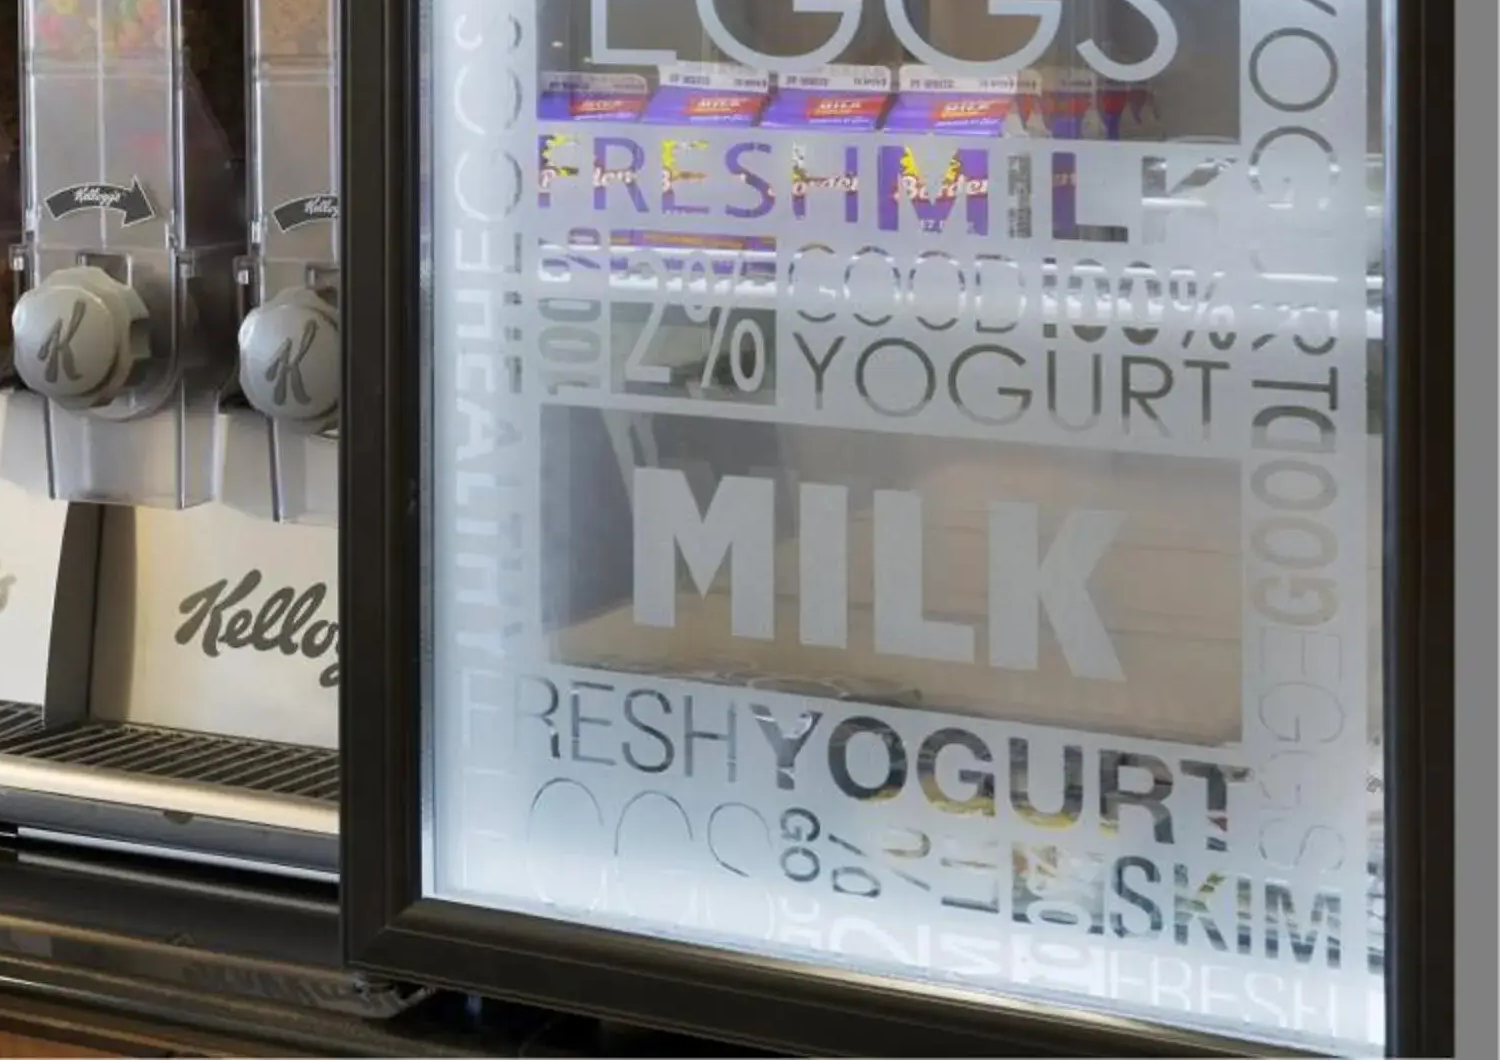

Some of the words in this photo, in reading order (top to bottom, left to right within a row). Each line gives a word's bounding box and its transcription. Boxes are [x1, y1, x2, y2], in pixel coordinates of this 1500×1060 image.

[537, 134, 859, 224] FRESH
[877, 143, 1238, 243] MILK
[37, 300, 87, 382] K
[265, 319, 319, 406] K
[792, 331, 1232, 440] YOGURT
[1249, 404, 1338, 627] GOOD
[632, 466, 1128, 682] MILK
[750, 702, 1255, 852] YOGURT
[1111, 854, 1342, 968] SKIM
